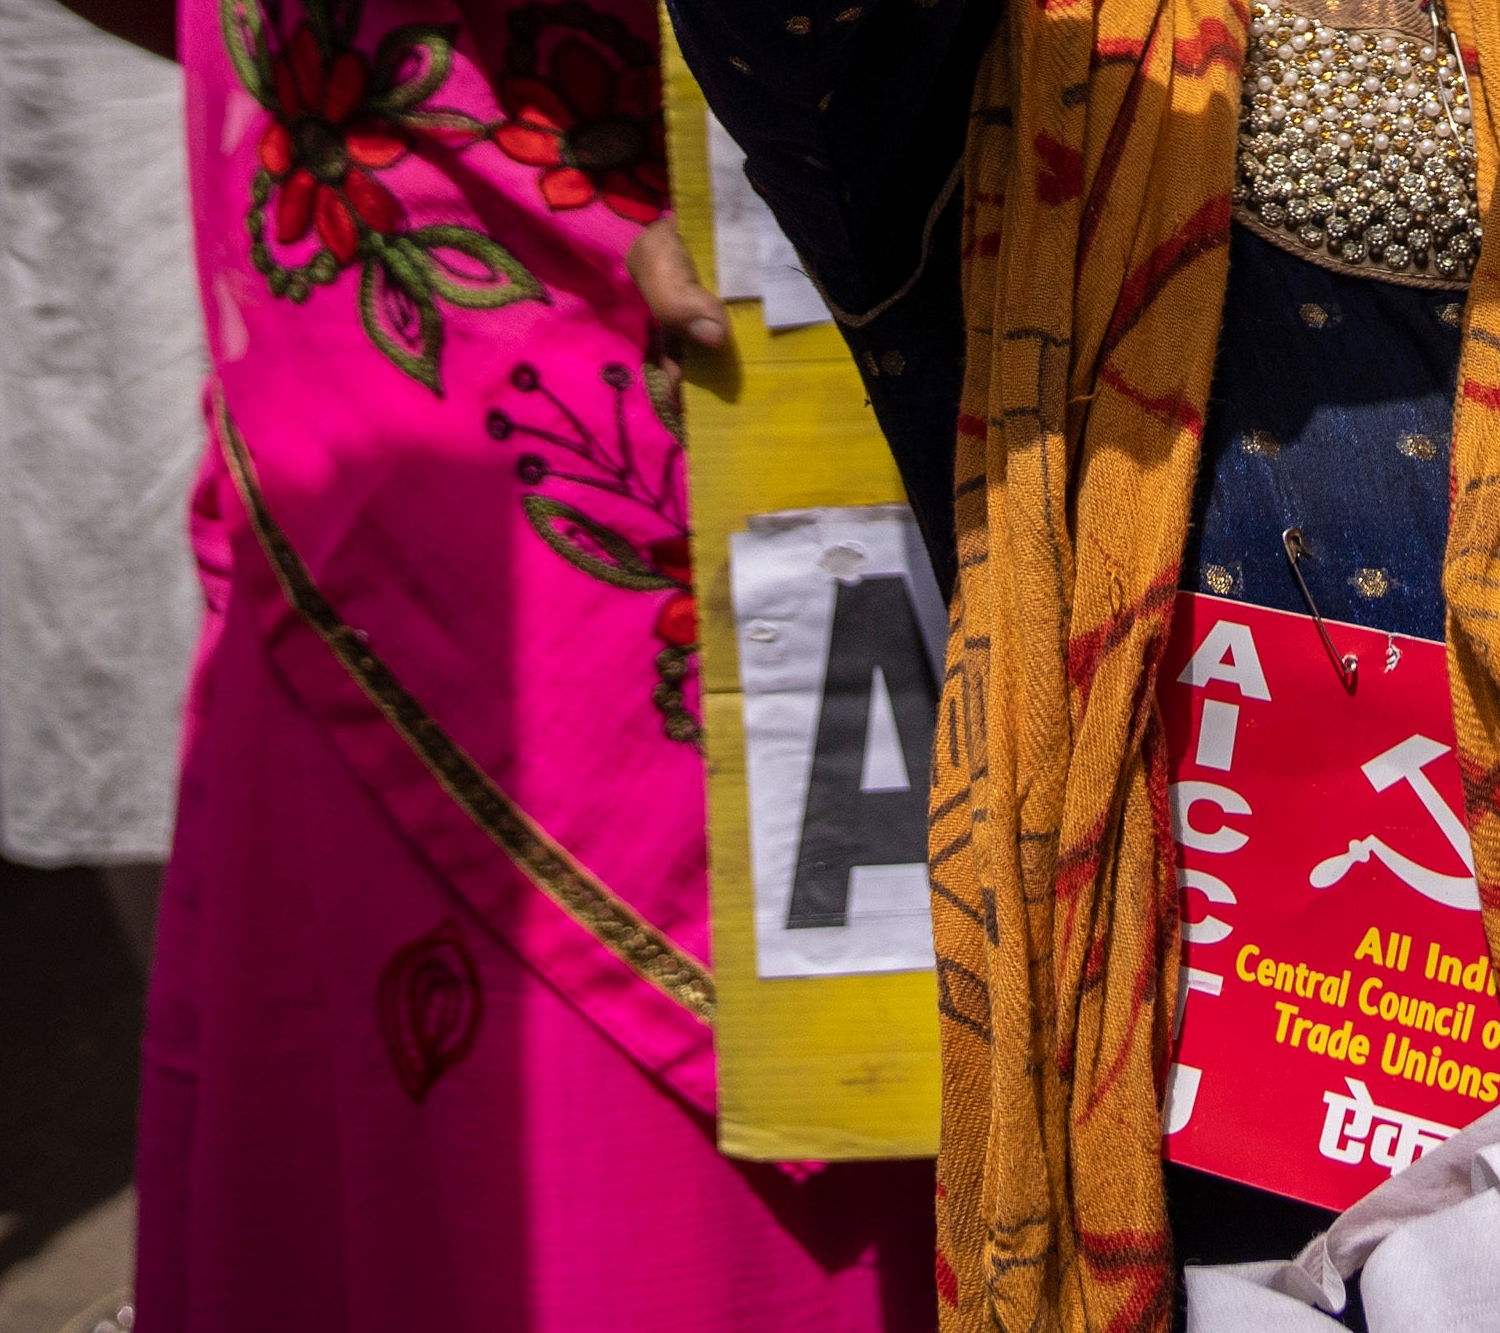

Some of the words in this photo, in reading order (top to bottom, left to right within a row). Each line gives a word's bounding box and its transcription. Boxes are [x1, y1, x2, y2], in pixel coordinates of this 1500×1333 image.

[786, 573, 932, 930] A
[1236, 944, 1351, 1008] Central
[1358, 977, 1475, 1043] Council
[1355, 927, 1412, 973] All
[1425, 943, 1498, 997] Ind
[1275, 1002, 1370, 1066] Trade
[1381, 1033, 1500, 1102] Unions
